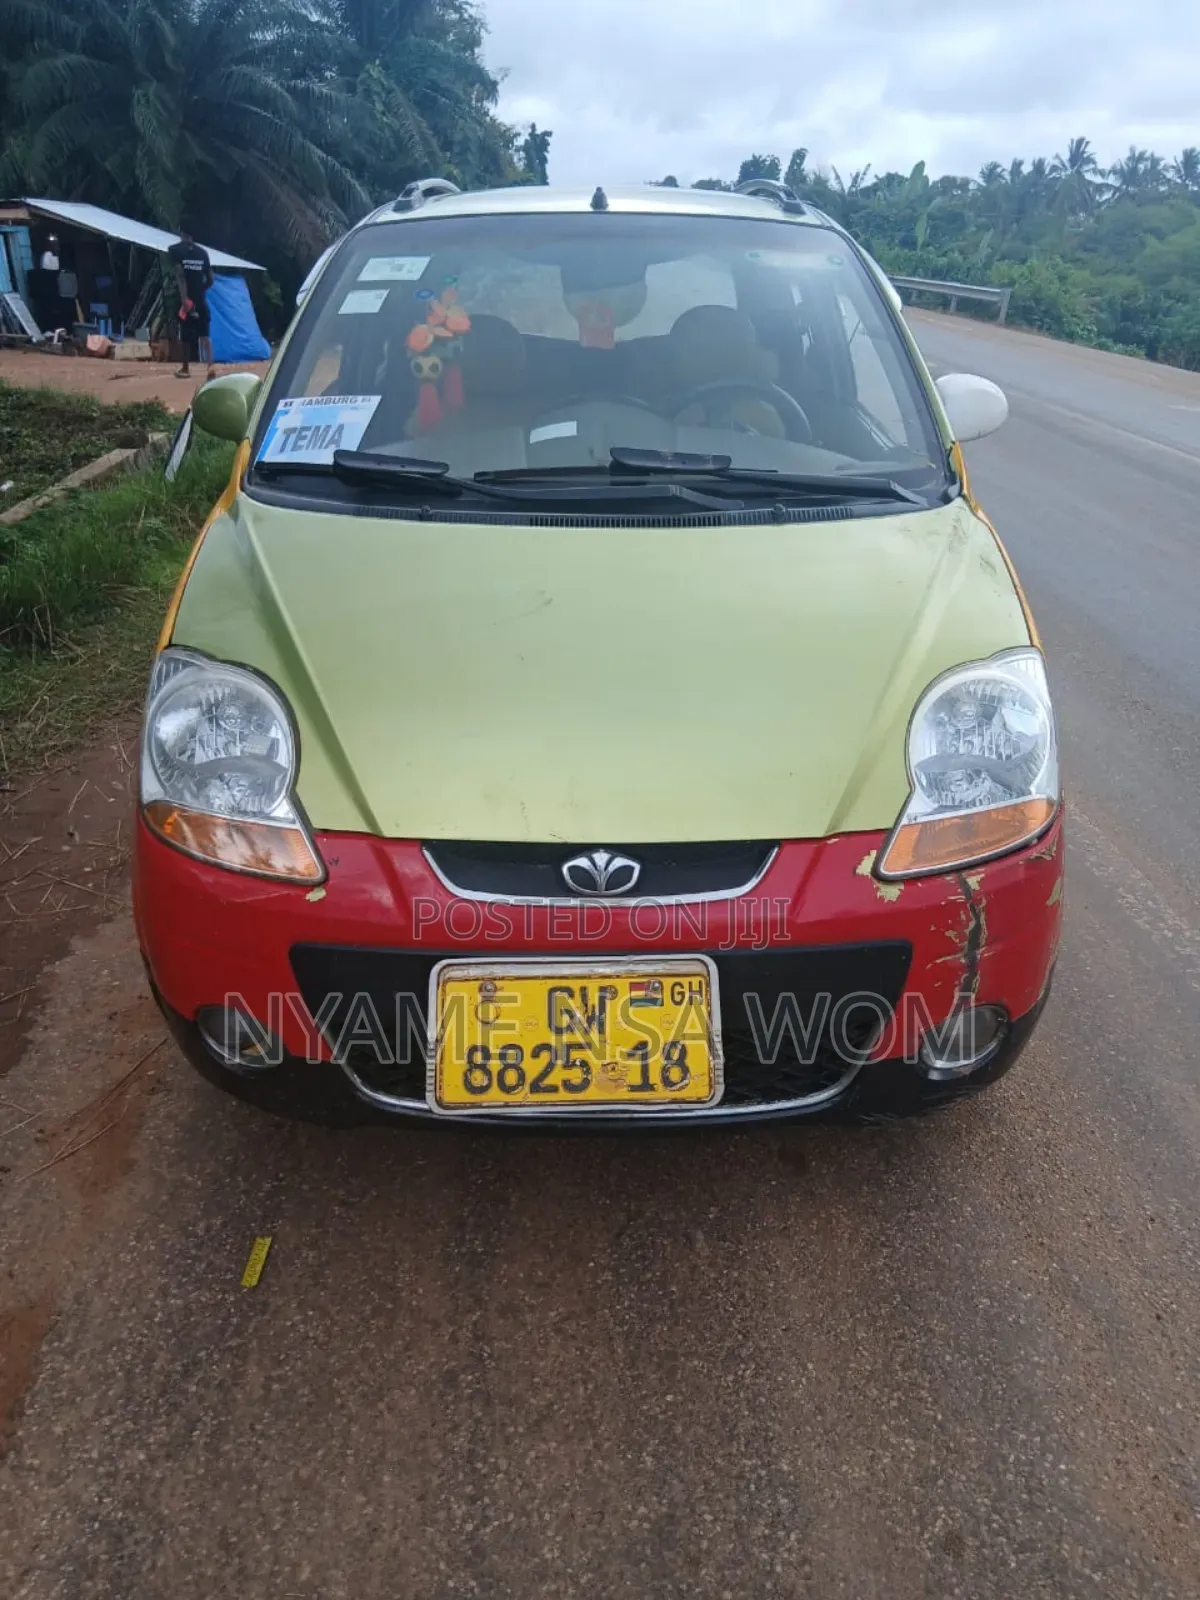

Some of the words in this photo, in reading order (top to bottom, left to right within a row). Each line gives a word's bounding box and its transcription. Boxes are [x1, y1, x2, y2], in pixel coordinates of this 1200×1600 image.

[279, 423, 345, 454] TEMA
[670, 981, 704, 1006] GH
[463, 1043, 593, 1095] 8825
[625, 1040, 691, 1092] 18
